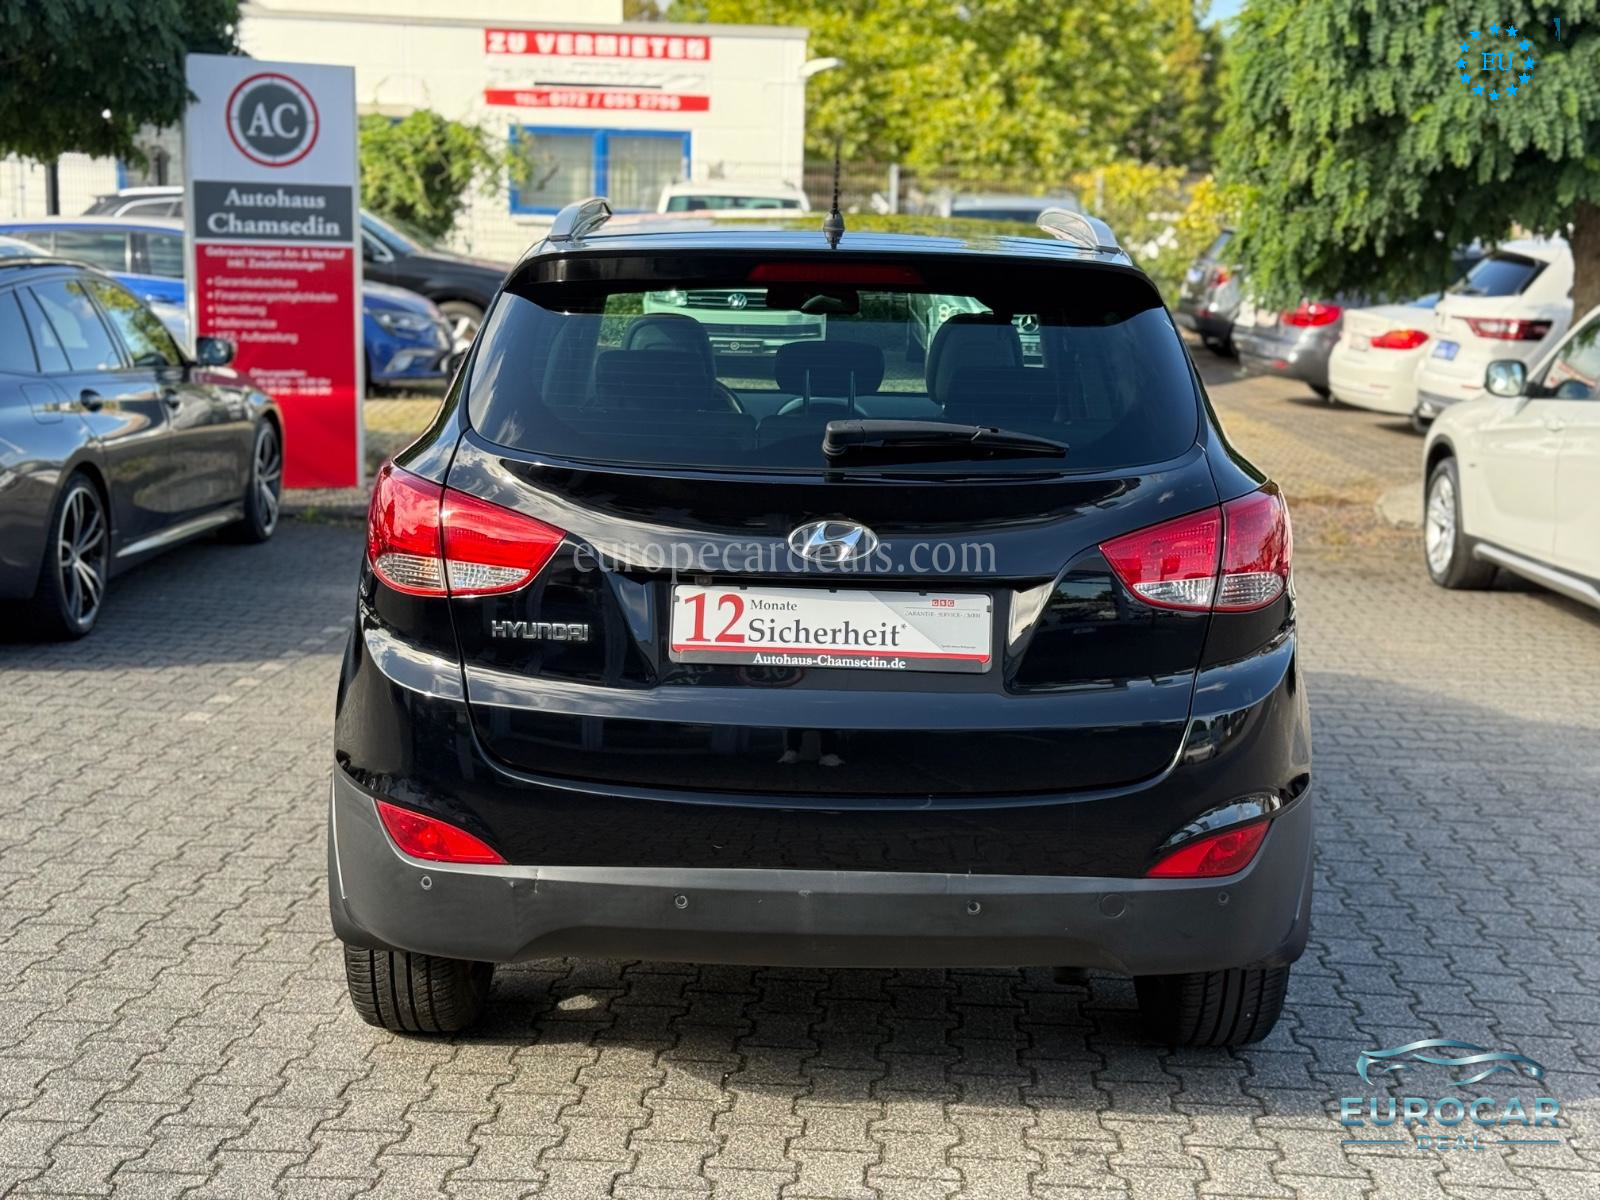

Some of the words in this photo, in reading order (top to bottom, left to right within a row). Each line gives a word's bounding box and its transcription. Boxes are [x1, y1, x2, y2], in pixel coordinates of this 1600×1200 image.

[487, 31, 528, 54] ZU
[534, 33, 706, 60] VERMIETEN
[246, 102, 299, 138] AC
[224, 187, 327, 209] Autohaus
[207, 212, 340, 237] Chamsedin
[491, 620, 589, 641] HYUNDAI
[684, 592, 746, 644] 12
[750, 599, 798, 611] Monate
[753, 652, 906, 669] Autohaus-Chamsedin.de
